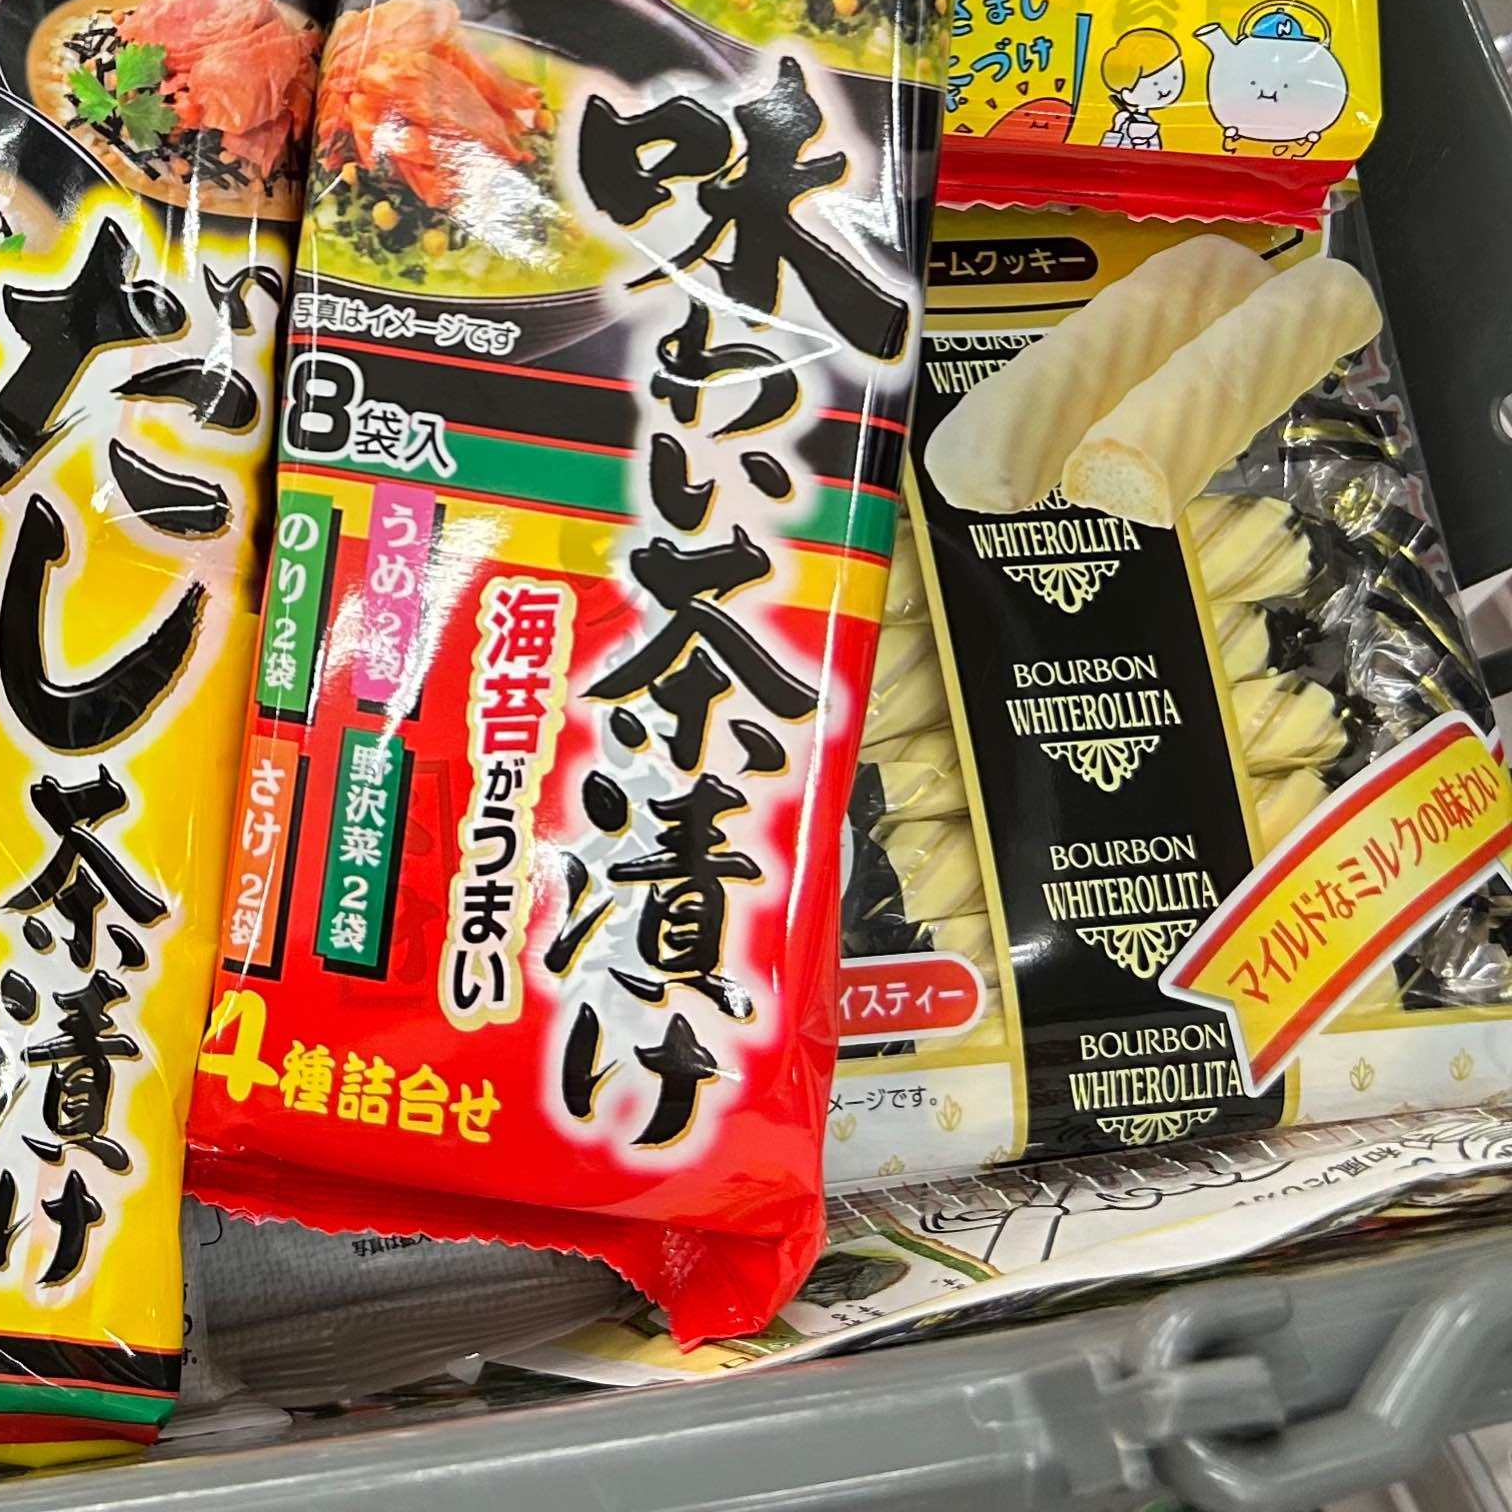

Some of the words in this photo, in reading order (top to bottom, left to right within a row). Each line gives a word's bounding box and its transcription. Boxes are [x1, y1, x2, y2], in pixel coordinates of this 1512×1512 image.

[292, 297, 519, 353] 写真はイメージです
[285, 354, 456, 477] 8袋入
[968, 517, 1141, 560] WHITEROLLITA
[542, 54, 908, 1148] 味わい茶漬け
[1013, 654, 1158, 687] BOURBON
[1007, 690, 1182, 737] WHITEROLLITA
[451, 587, 564, 1011] 海苔がうまい
[1050, 835, 1196, 870] BOURBON
[1042, 872, 1219, 922] WHITEROLLITA
[1227, 763, 1500, 1006] マイルドなミルクの味わい
[197, 989, 501, 1144] 4種詰合せ
[1081, 1023, 1226, 1060] BOURBON
[1070, 1061, 1244, 1111] WHITEROLLITA
